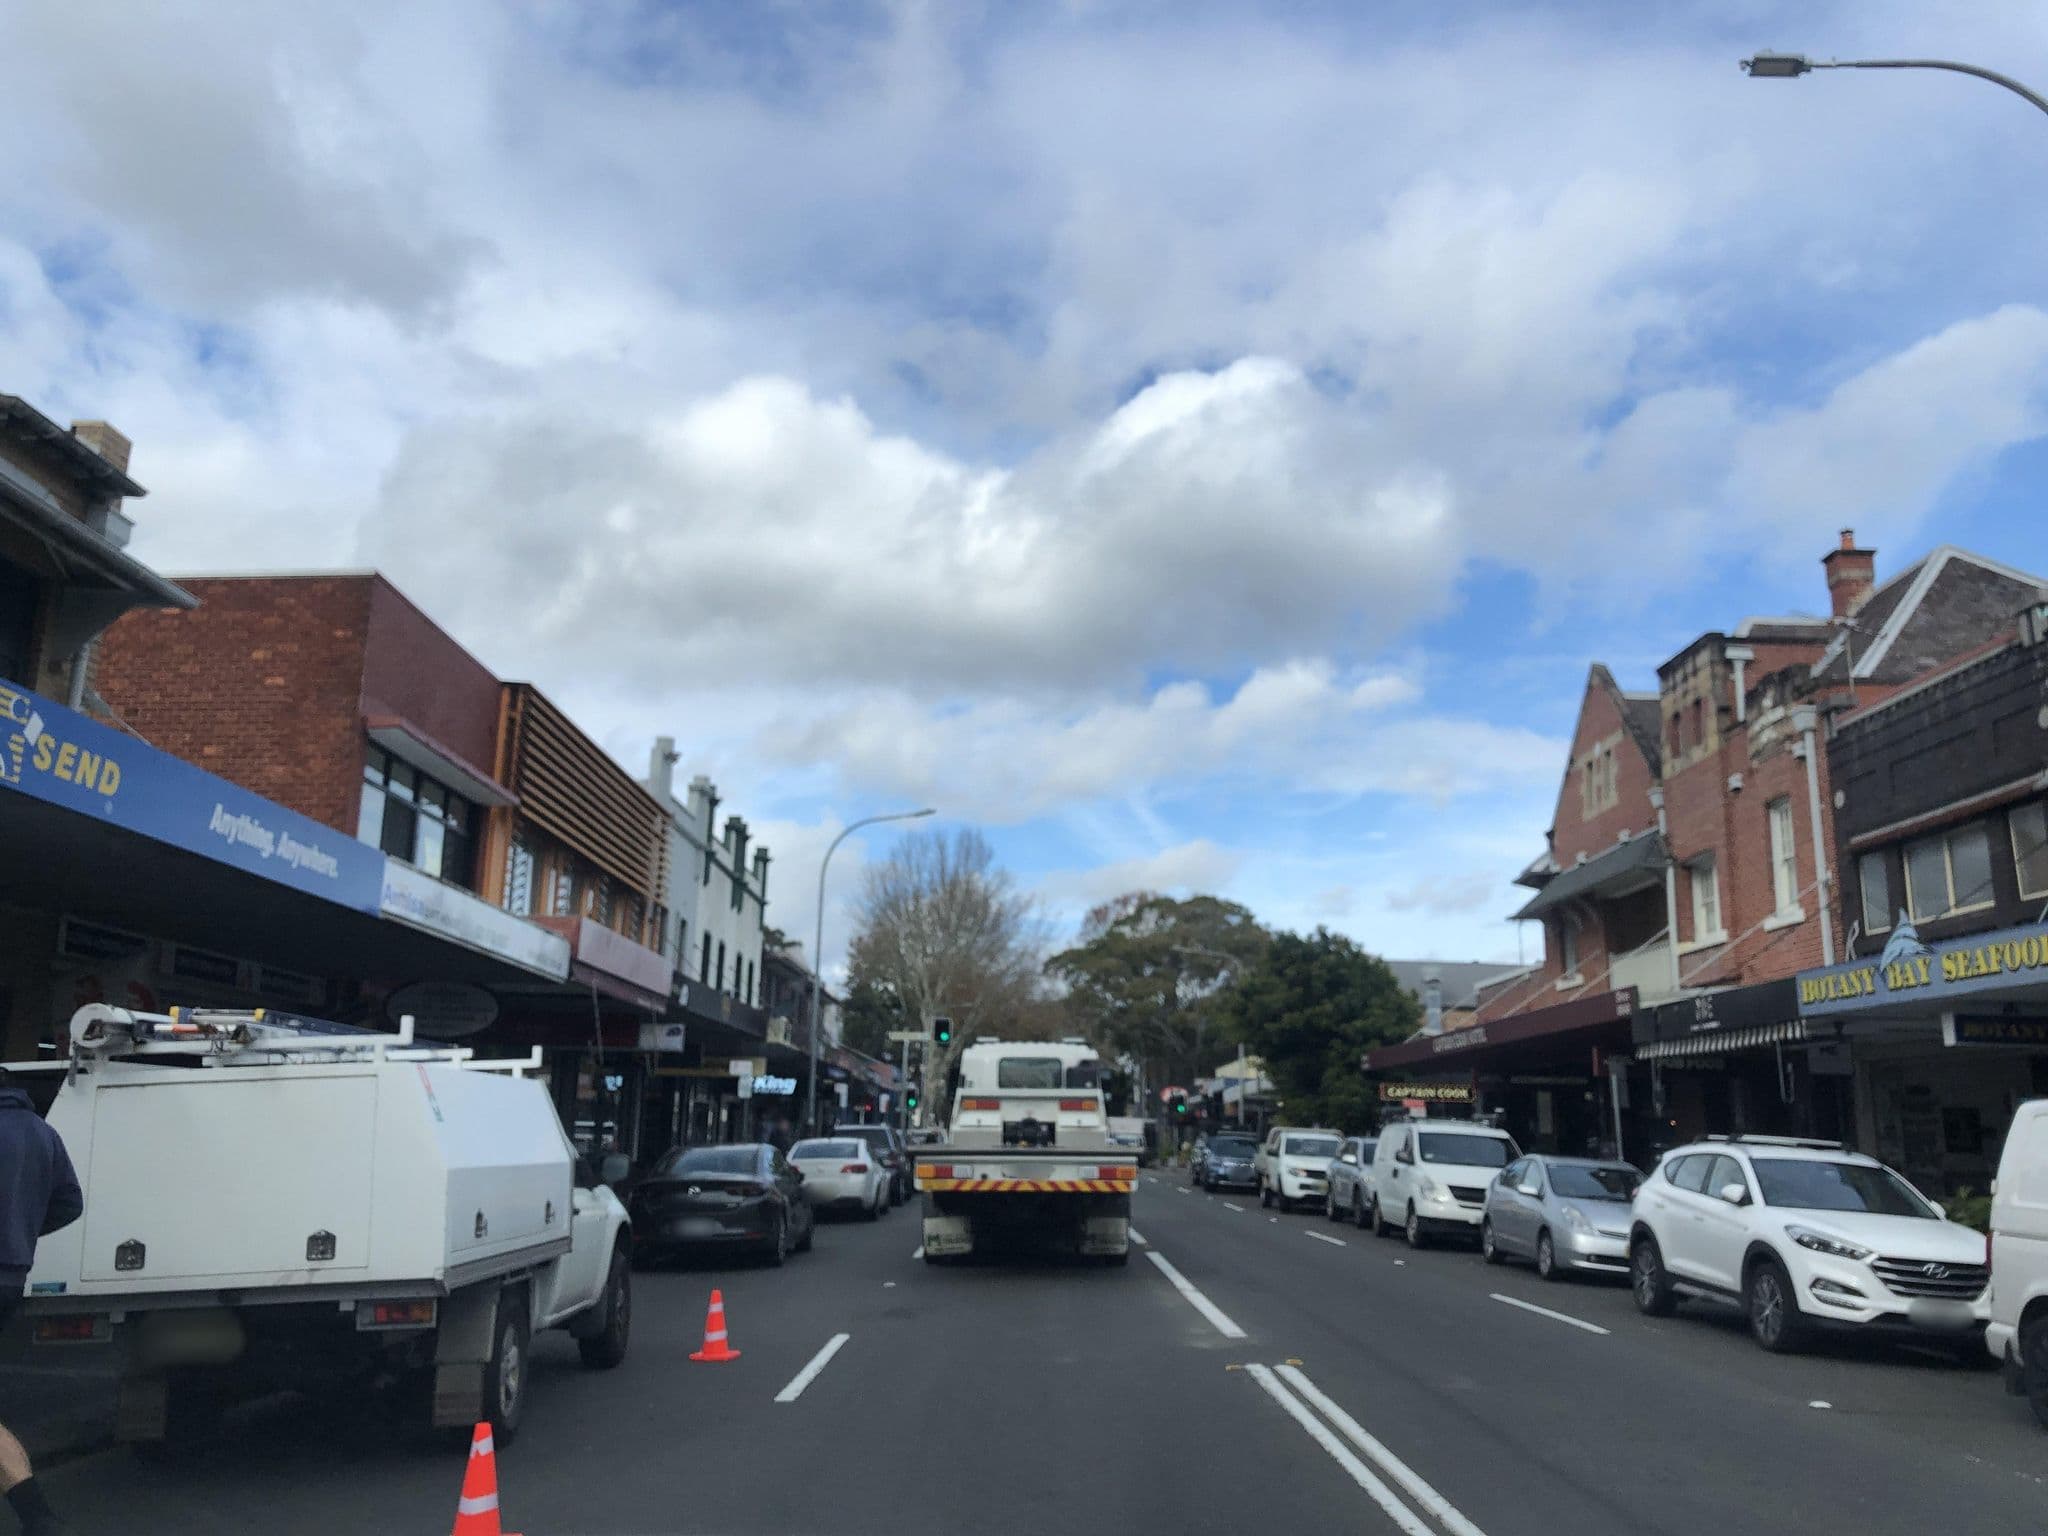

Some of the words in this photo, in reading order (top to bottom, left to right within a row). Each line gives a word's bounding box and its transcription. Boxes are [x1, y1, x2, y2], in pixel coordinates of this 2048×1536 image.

[33, 734, 121, 796] SEND
[1802, 967, 1876, 1004] BOTANY
[1886, 956, 1931, 991] BAY
[1387, 1086, 1436, 1098] CAPTAIN
[1437, 1086, 1469, 1099] COOK
